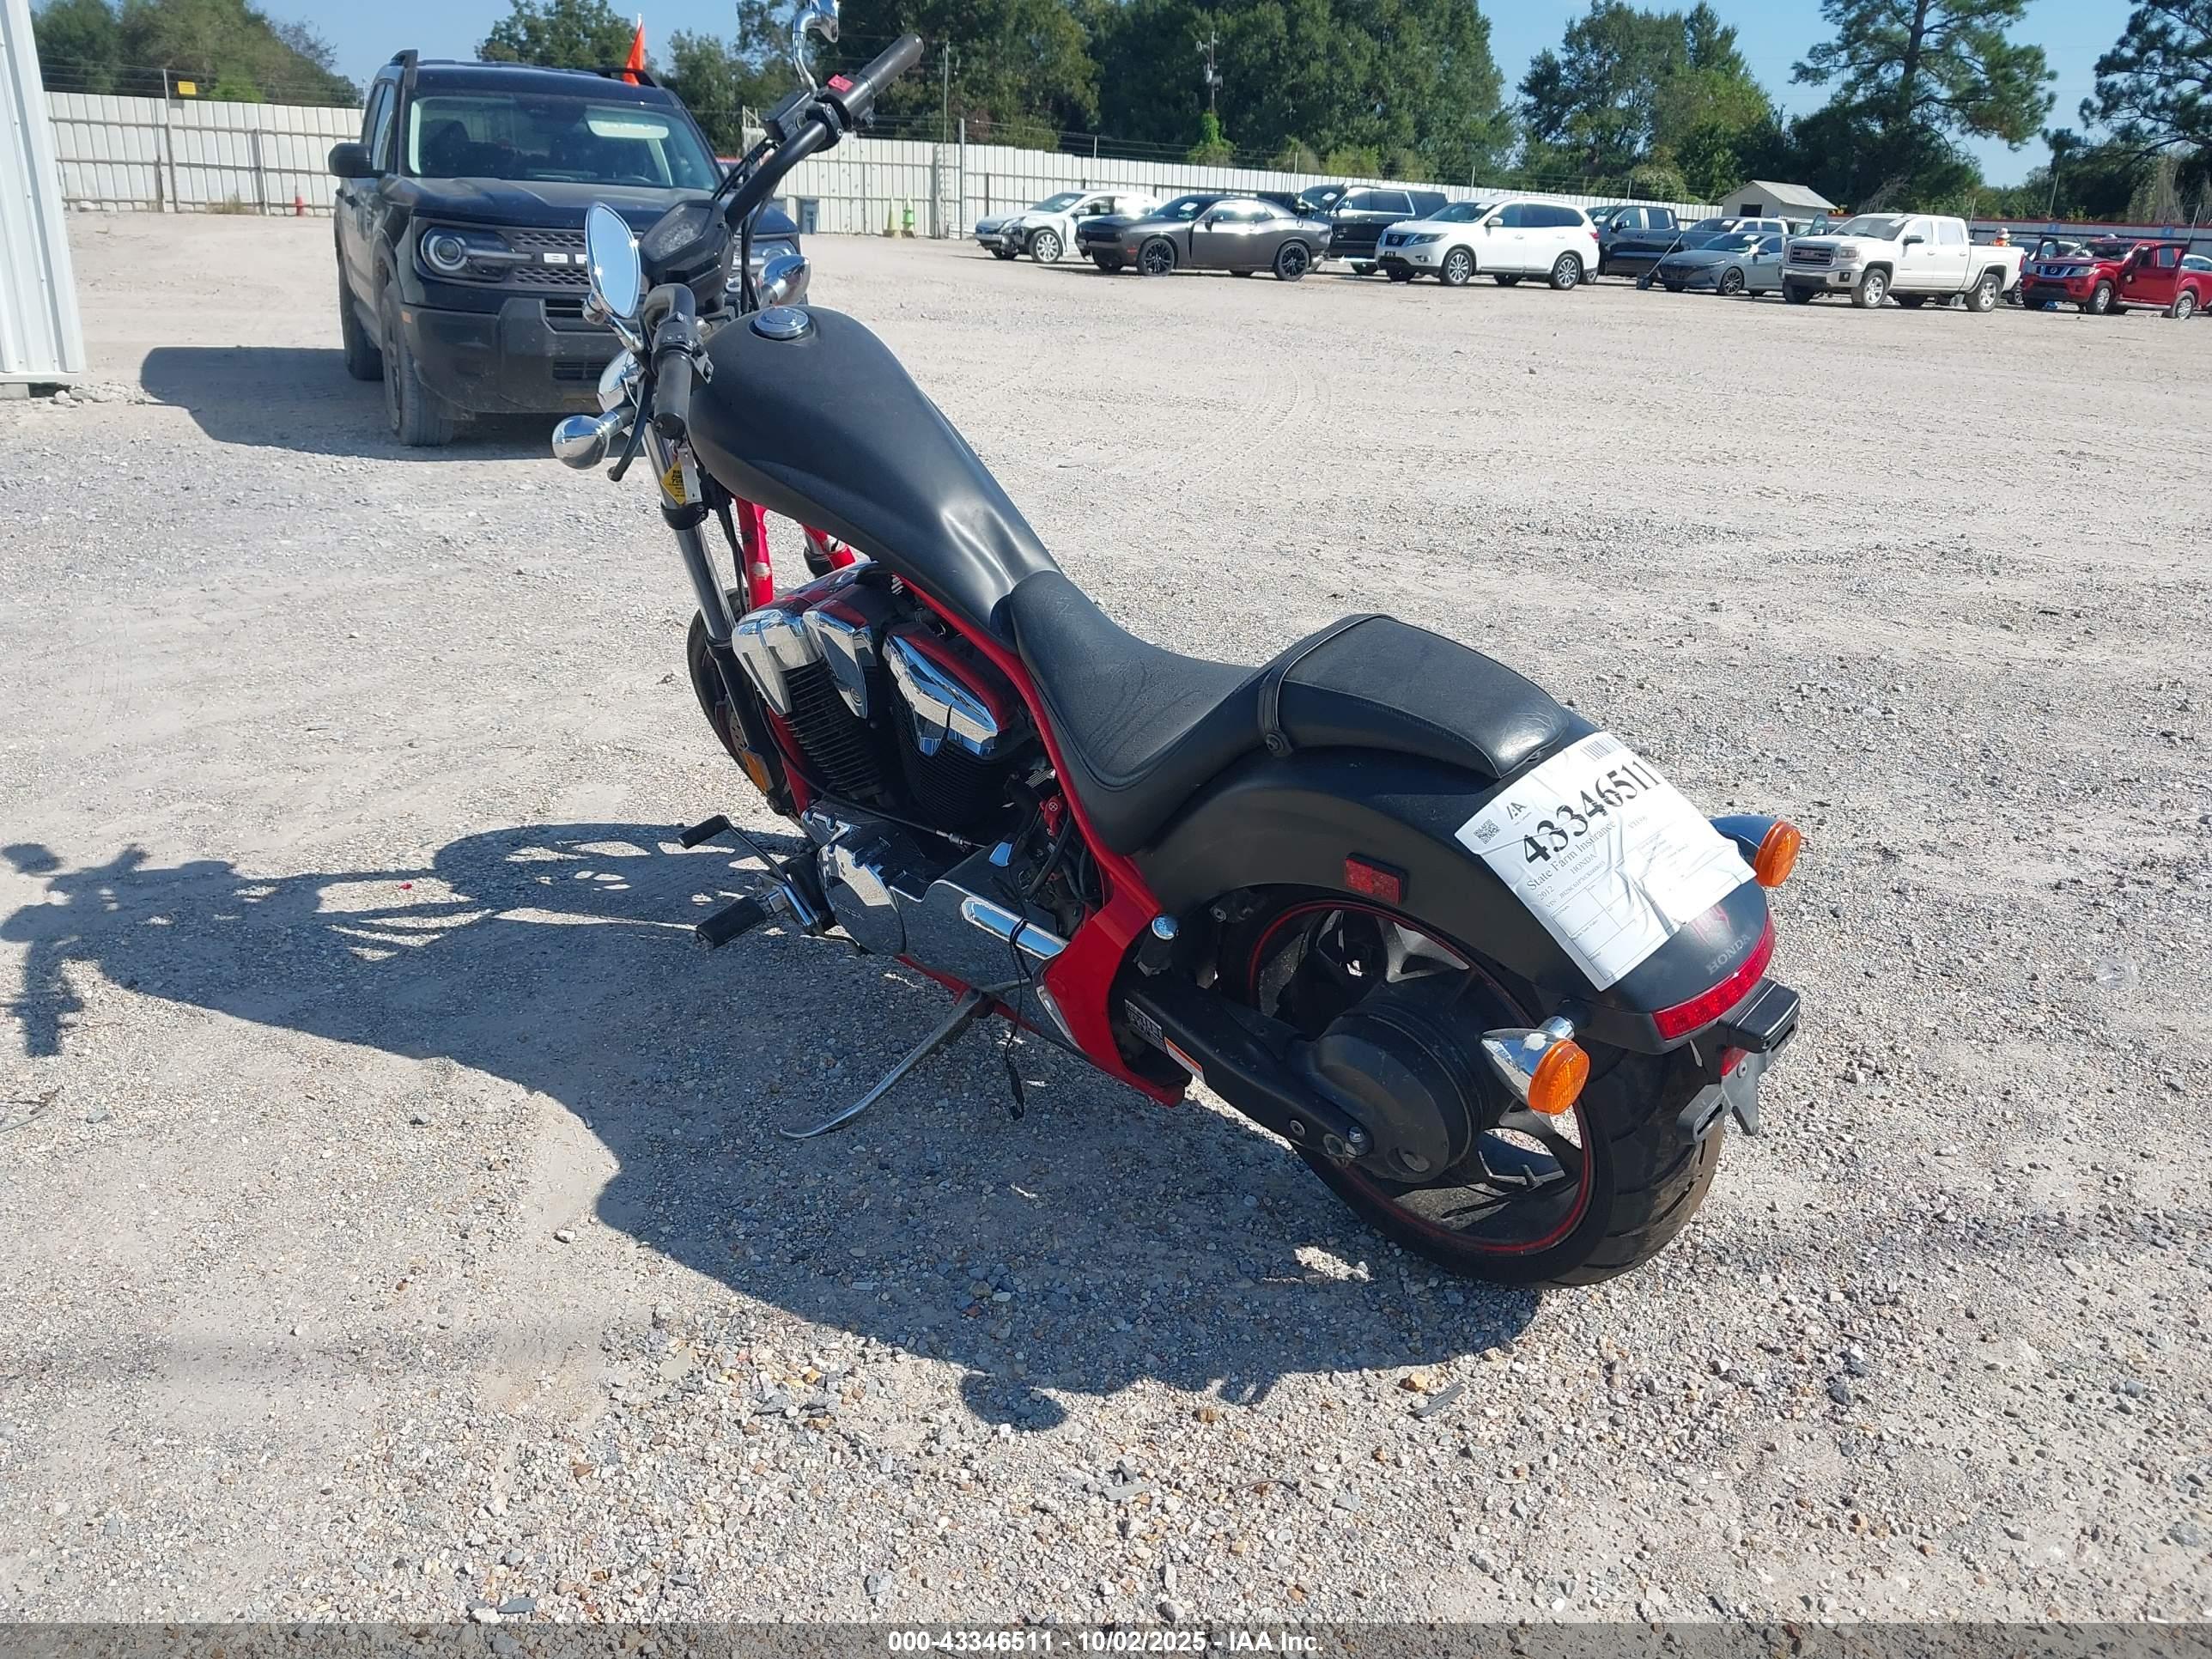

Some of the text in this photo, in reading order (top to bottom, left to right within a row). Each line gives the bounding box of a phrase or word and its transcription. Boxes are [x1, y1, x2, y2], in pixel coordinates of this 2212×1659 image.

[1523, 760, 1661, 864] 43346511
[1526, 868, 1553, 890] State
[1550, 849, 1578, 872] Farm
[1575, 820, 1617, 857] Insurance
[1537, 885, 1555, 902] 2012
[1570, 853, 1598, 875] HONDA
[1705, 933, 1751, 976] HONDA
